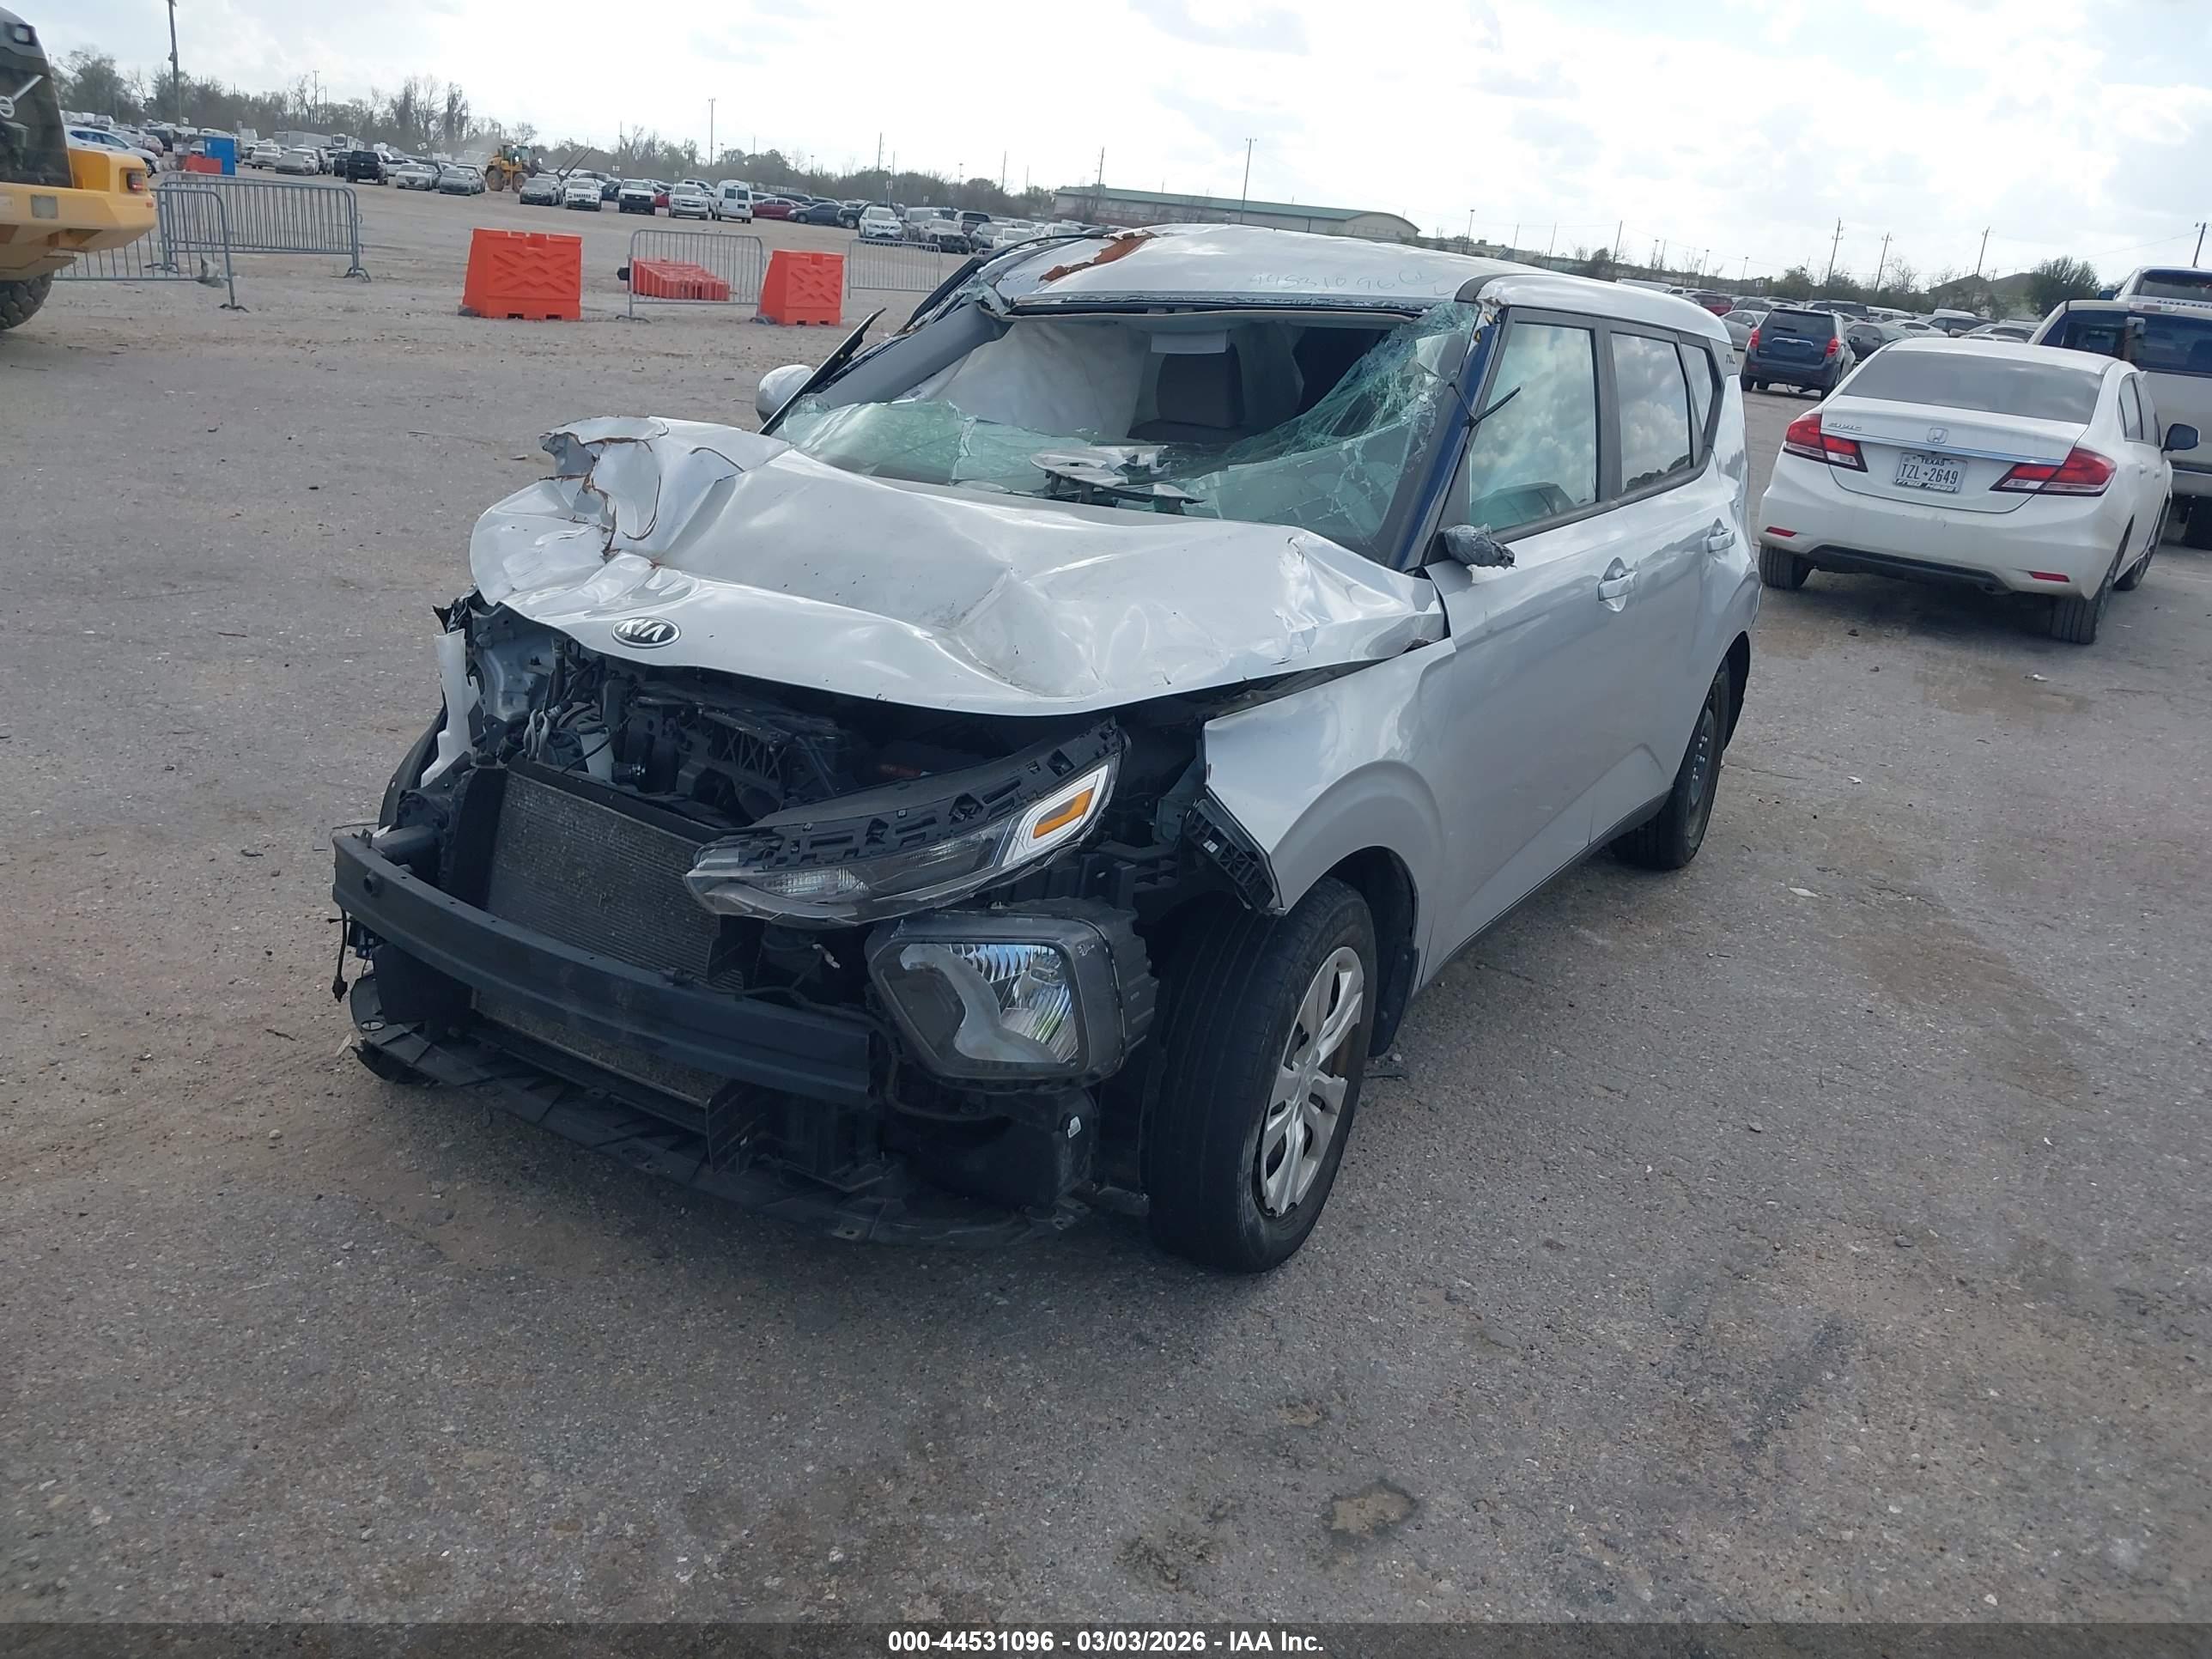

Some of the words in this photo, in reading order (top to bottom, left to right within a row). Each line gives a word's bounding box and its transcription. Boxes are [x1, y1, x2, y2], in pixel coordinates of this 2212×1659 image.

[1920, 457, 1946, 466] TEXAS
[1901, 464, 1920, 479] TZL
[1928, 468, 1959, 484] 2649
[617, 618, 667, 642] KIA
